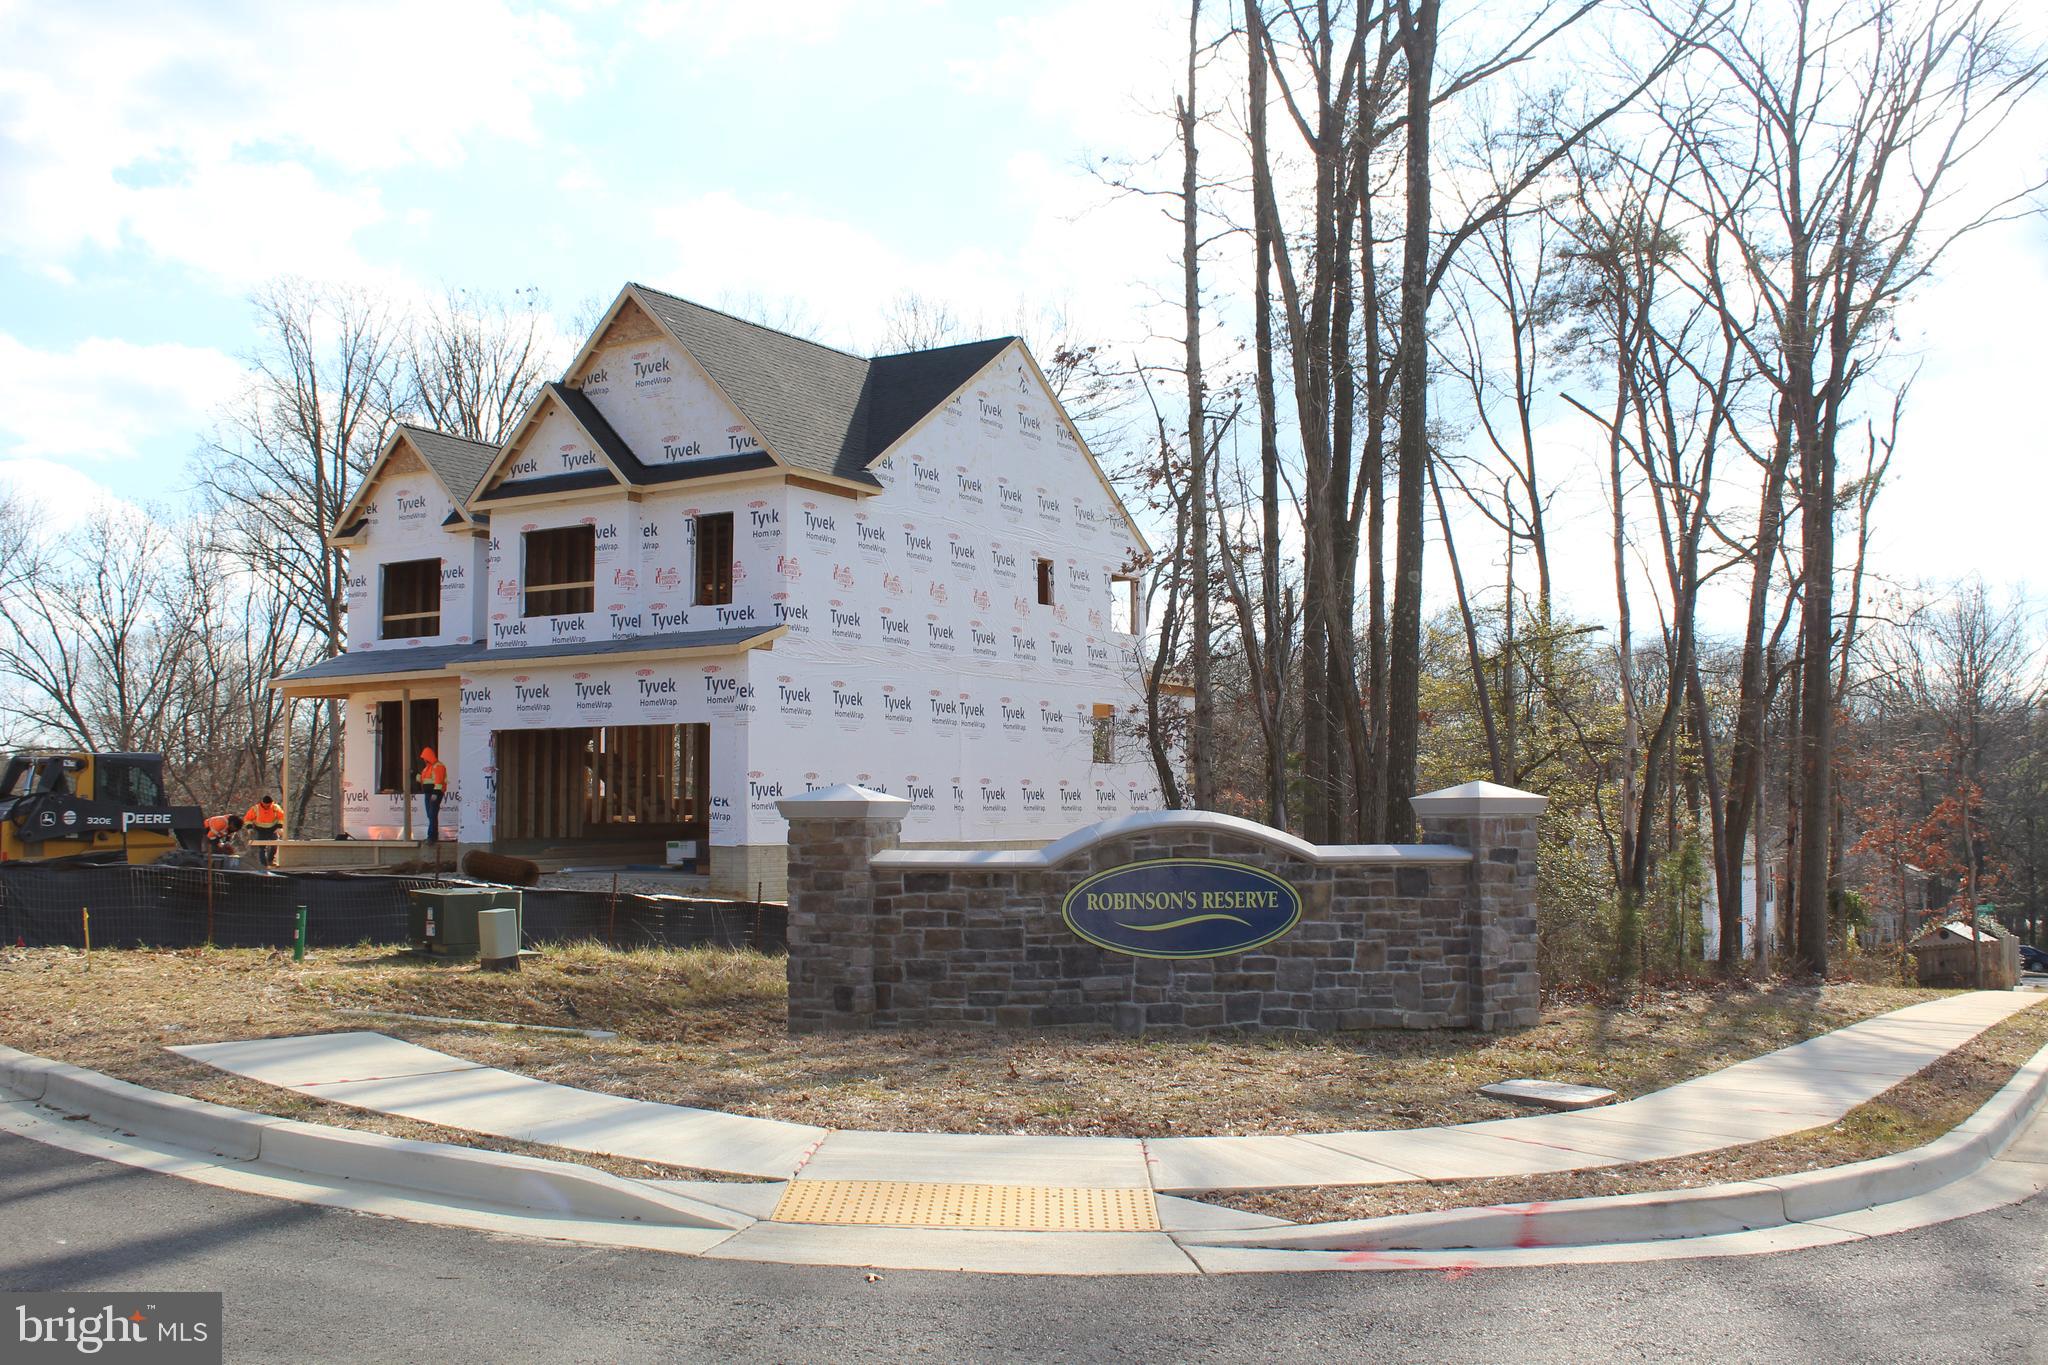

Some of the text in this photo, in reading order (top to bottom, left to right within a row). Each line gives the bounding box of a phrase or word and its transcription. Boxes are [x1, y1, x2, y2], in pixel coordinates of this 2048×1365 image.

[633, 358, 670, 378] Tyvek
[635, 376, 671, 388] HomeWrap
[979, 399, 1002, 418] Tyvek
[1018, 412, 1040, 430] Tyvek
[664, 441, 700, 461] Tyvek
[728, 436, 758, 452] Tyve
[562, 451, 596, 470] Tyvek
[913, 463, 939, 481] Tyvek
[957, 474, 982, 492] Tyvek
[999, 485, 1022, 503] Tyvek
[397, 496, 426, 512] Tyvek
[1038, 495, 1060, 512] Tyvek
[1074, 505, 1095, 521] Tyvek
[805, 512, 835, 531] Tyvek
[806, 532, 836, 544] HomeWrap
[857, 522, 885, 541] Tyvek
[858, 542, 886, 553] HomeWrap
[905, 532, 931, 550] Tyvek
[906, 551, 932, 562] HomeWrap
[950, 542, 975, 559] Tyvek
[992, 551, 1016, 567] Tyvek
[1069, 567, 1090, 582] Tyvek
[716, 605, 755, 625] Tyvek
[774, 603, 808, 621] Tyvek
[830, 609, 860, 627] Tyvek
[551, 617, 585, 635] Tyvek
[652, 611, 688, 630] Tyvek
[881, 617, 909, 634] Tyvek
[494, 622, 526, 639] Tyvek
[832, 628, 861, 640] HomeWrap
[928, 623, 954, 640] Tyvek
[972, 630, 996, 645] Tyvek
[496, 640, 527, 648] HomeWrap
[552, 635, 586, 644] HomeWrap
[883, 635, 910, 646] HomeWrap
[1013, 635, 1035, 650] Tyvek
[1051, 640, 1073, 654] Tyvek
[1087, 646, 1107, 659] Tyvek
[516, 684, 549, 702] Tyvek
[575, 681, 611, 699] Tyvek
[639, 678, 676, 697] Tyvek
[705, 676, 736, 695] Tyve
[640, 698, 677, 707] HomeWrap
[707, 696, 735, 704] HomeW
[779, 686, 810, 704] Tyvek
[833, 691, 863, 708] Tyvek
[517, 703, 550, 712] HomeWrap
[577, 701, 612, 710] HomeWrap
[781, 706, 812, 716] HomeWrap
[884, 695, 912, 712] Tyvek
[931, 699, 956, 716] Tyvek
[960, 702, 984, 719] Tyvek
[835, 710, 864, 719] HomeWrap
[885, 714, 912, 723] HomeWrap
[1002, 706, 1025, 721] Tyvek
[1041, 709, 1063, 724] Tyvek
[932, 718, 957, 726] HomeWrap
[961, 720, 985, 728] HomeWrap
[1003, 723, 1026, 731] HomeWrap
[750, 782, 783, 801] Tyvek
[908, 785, 934, 802] Tyvek
[981, 787, 1005, 803] Tyvek
[1022, 788, 1045, 803] Tyvek
[1060, 789, 1081, 803] Tyvek
[1096, 789, 1115, 803] Tyvek
[1130, 790, 1148, 803] Tyvek
[125, 813, 171, 824] DEERE
[1086, 890, 1279, 911] ROBINSON'S RESERVE
